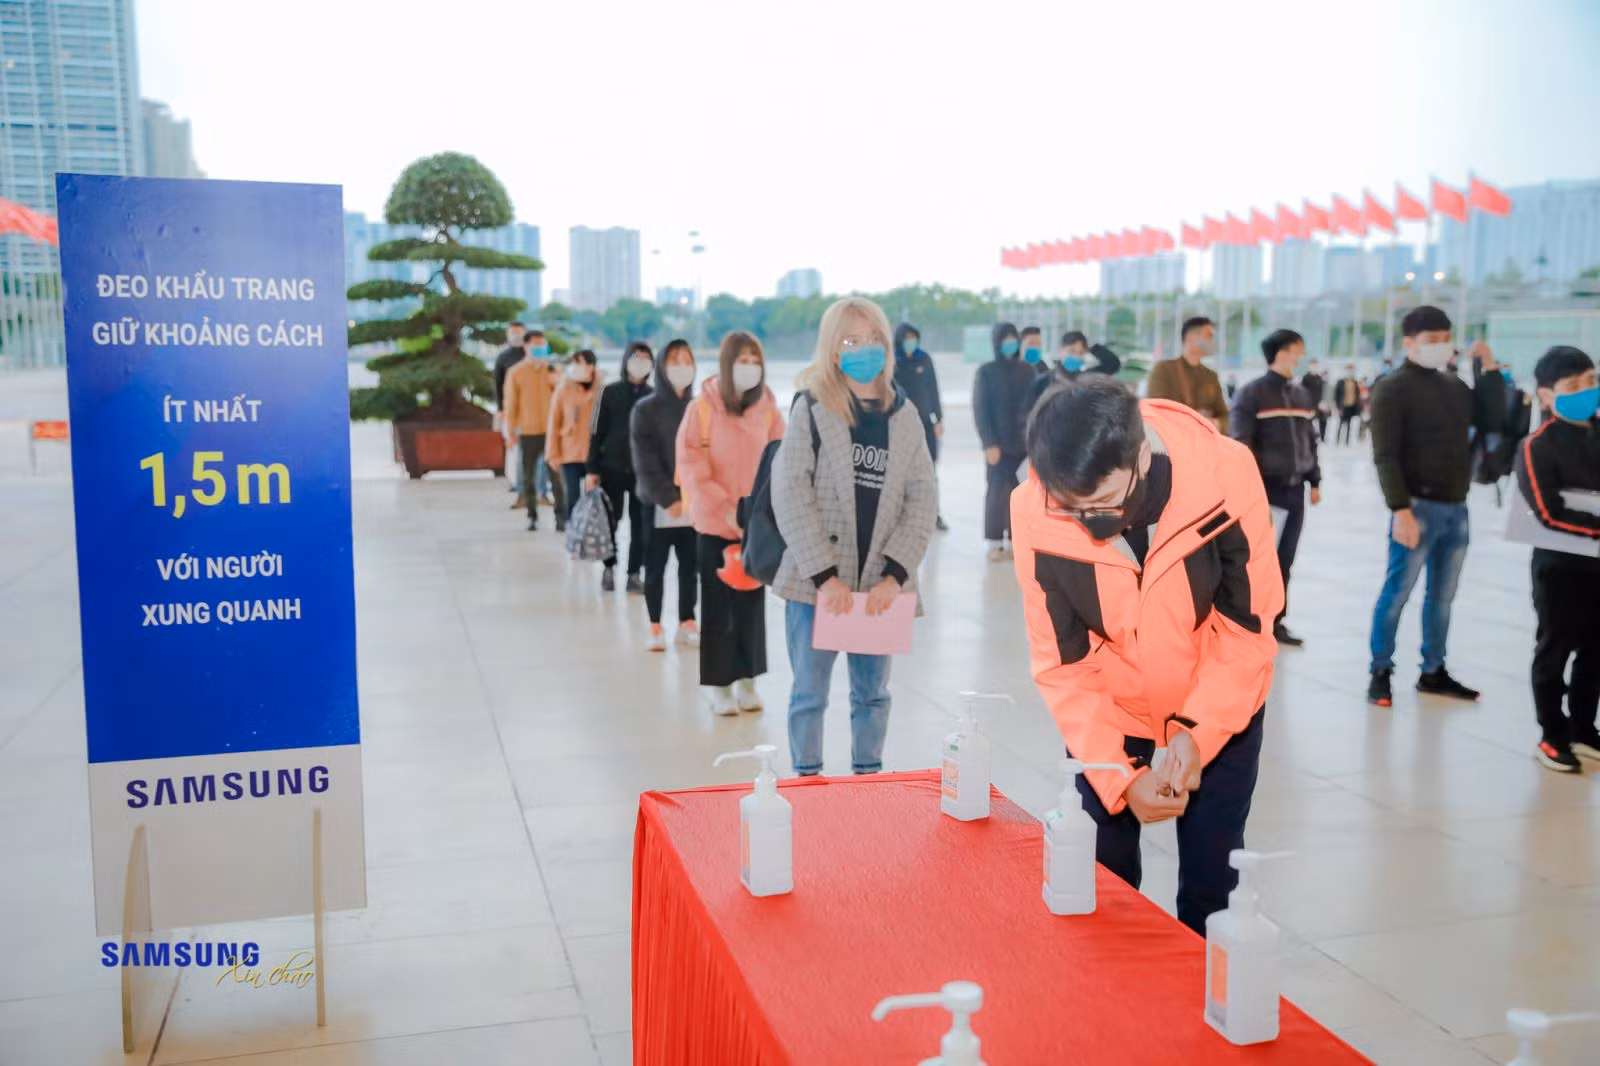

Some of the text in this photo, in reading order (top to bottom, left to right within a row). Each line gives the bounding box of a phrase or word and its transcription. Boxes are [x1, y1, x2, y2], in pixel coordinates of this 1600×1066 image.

[96, 269, 315, 302] ĐEO KHẨU TRANG
[92, 316, 324, 347] GIỮ KHOẢNG CÁCH
[163, 393, 262, 423] ÍT NHẤT
[156, 550, 284, 581] VỚI NGƯỜI
[141, 598, 302, 627] XUNG QUANH
[126, 765, 330, 809] SAMSUNG
